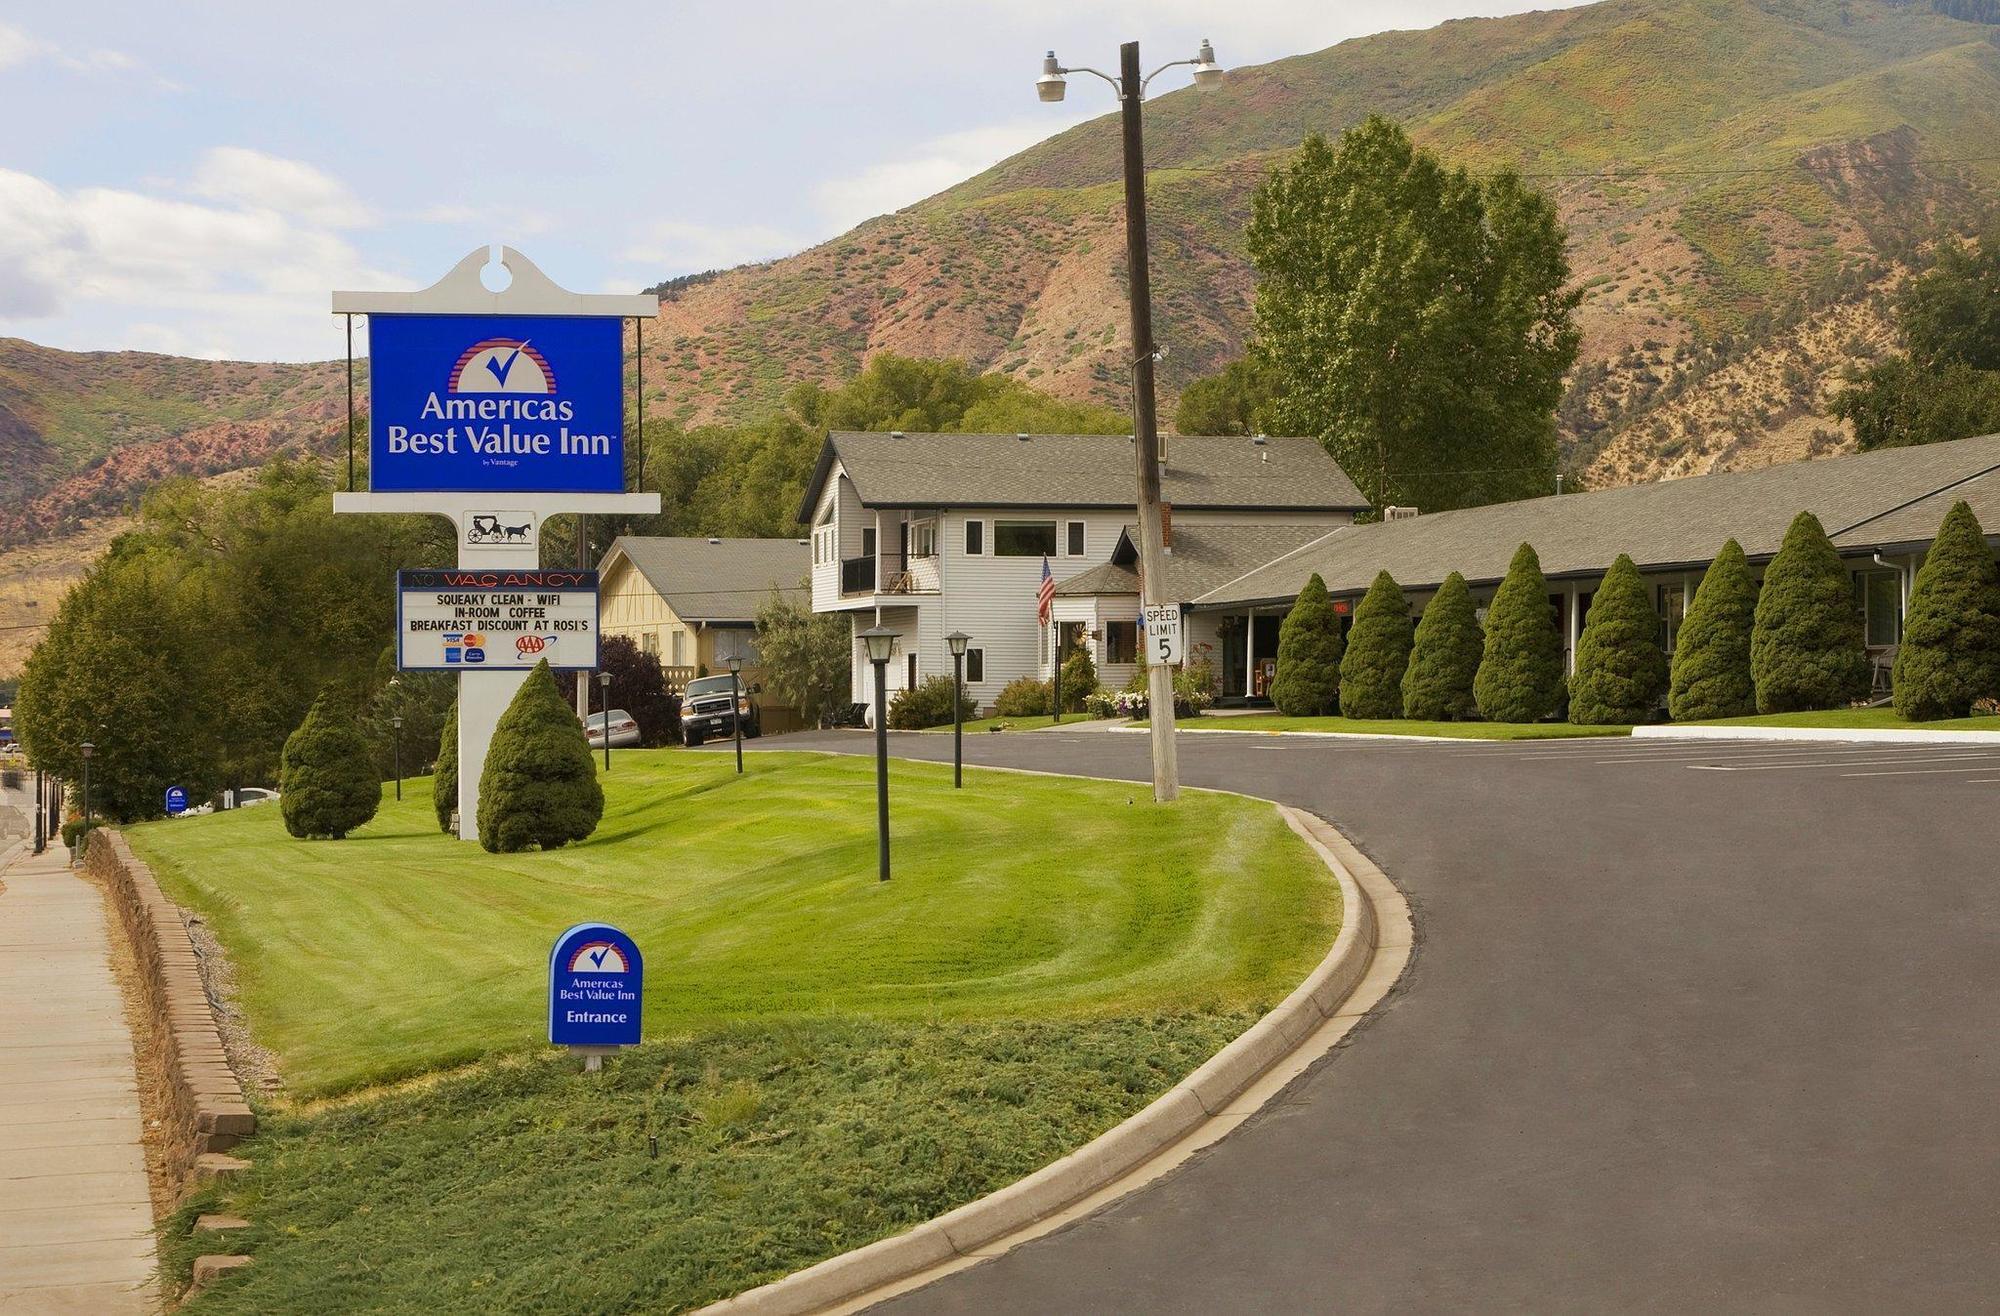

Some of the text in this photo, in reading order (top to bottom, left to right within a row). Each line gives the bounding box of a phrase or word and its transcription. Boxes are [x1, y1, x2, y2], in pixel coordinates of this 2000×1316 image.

[420, 391, 574, 421] Americas
[388, 424, 610, 455] Best Value Inn
[412, 573, 585, 588] NO VACANCY
[437, 594, 486, 606] SQUEAKY
[491, 594, 524, 605] CLEAN
[536, 594, 561, 605] WIFI
[454, 607, 546, 618] IN-ROOM COFFEE
[1146, 609, 1178, 622] SPEED
[410, 620, 589, 631] BREAKFAST DISCOUNT AT ROSI'S
[1149, 623, 1177, 636] LIMIT
[519, 636, 541, 653] AAA
[1159, 638, 1172, 660] 5
[571, 978, 624, 989] Americas
[560, 989, 635, 1000] Best Value Inn
[567, 1010, 627, 1023] Entrance
